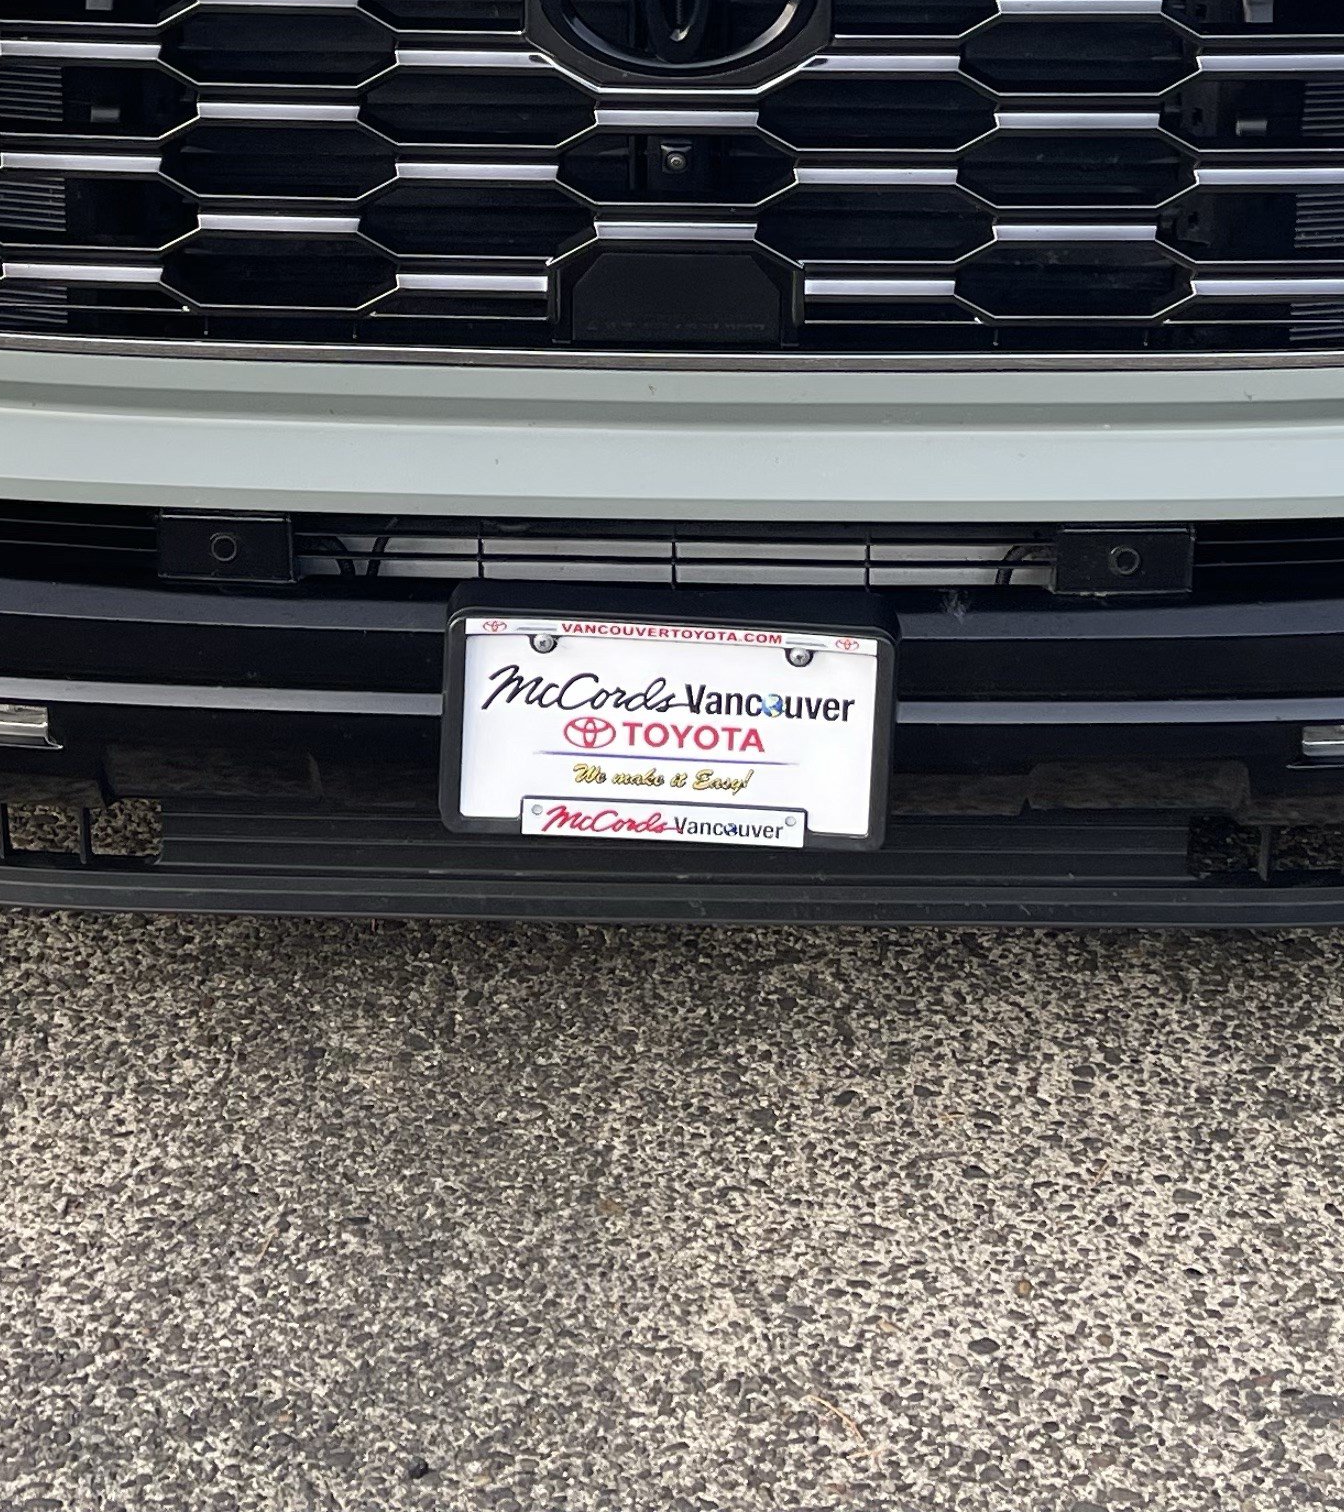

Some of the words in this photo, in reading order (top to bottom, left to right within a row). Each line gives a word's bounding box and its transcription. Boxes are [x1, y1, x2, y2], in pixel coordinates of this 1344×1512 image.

[561, 622, 783, 645] VANCOUVERTOYOTA.COM
[622, 721, 766, 753] TOYOTA
[572, 763, 607, 784] We
[611, 768, 665, 788] make
[670, 770, 688, 788] it
[692, 768, 755, 796] Easy!
